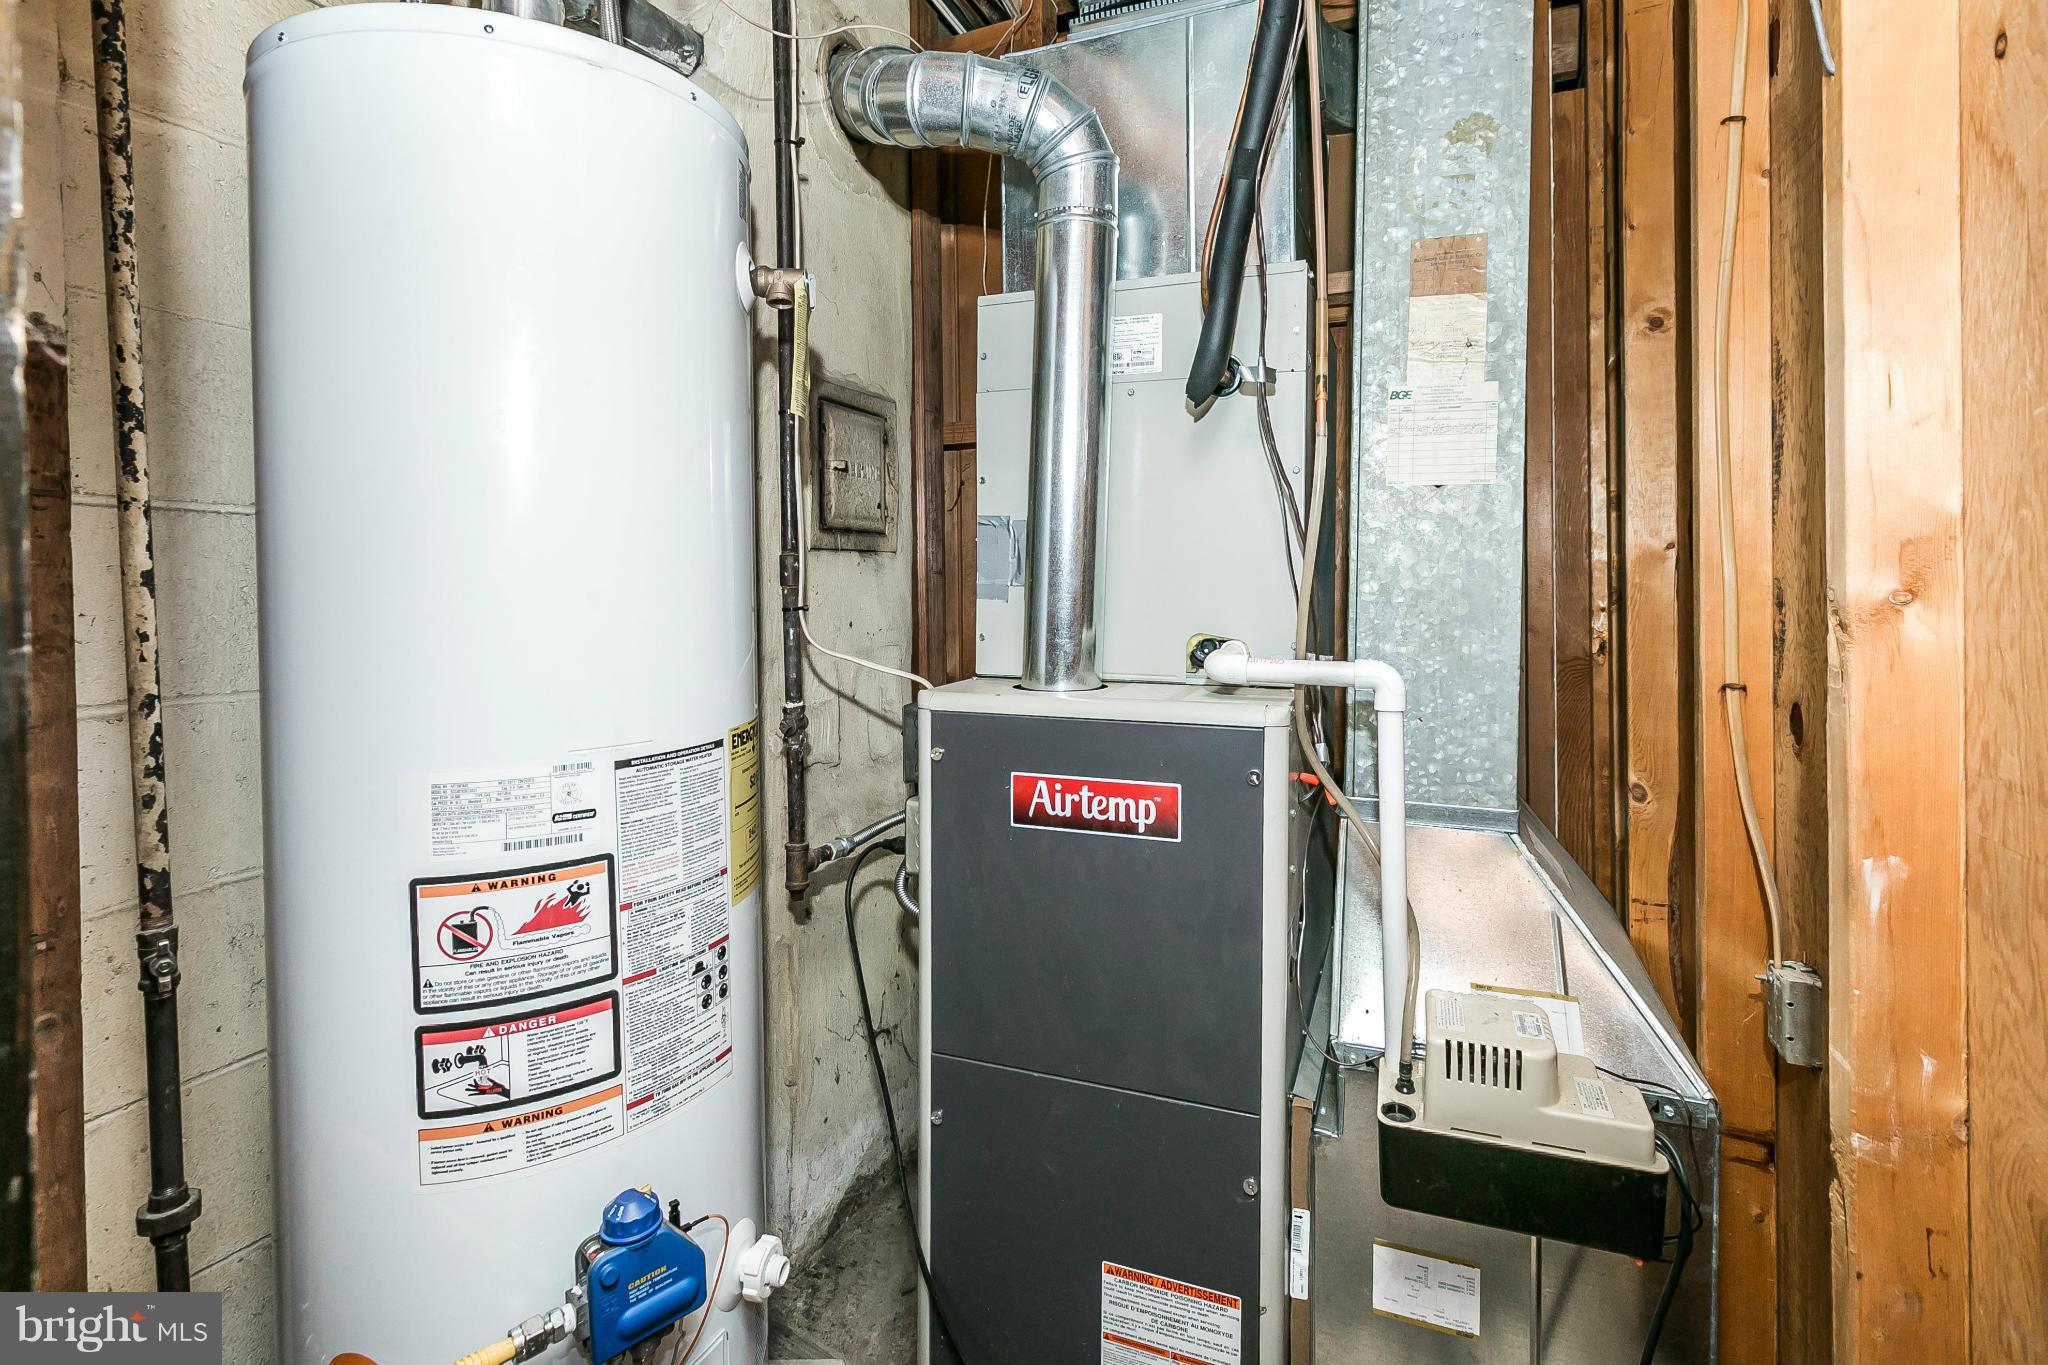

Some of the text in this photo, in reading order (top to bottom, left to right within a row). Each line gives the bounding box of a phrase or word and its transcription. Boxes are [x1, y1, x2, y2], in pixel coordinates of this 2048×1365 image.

[1390, 390, 1412, 400] BGE
[1028, 780, 1156, 833] Airtemp
[488, 873, 556, 890] WARNING
[512, 930, 574, 946] Flammable Vapors
[500, 954, 536, 964] EXPLOSION
[538, 948, 563, 958] HAZARD
[498, 1016, 557, 1034] DANGER
[501, 1106, 564, 1128] WARNING
[628, 1264, 667, 1290] CAUTION
[1114, 1266, 1153, 1285] WARNING
[1160, 1278, 1236, 1308] ADVERTISSEMENT
[1114, 1277, 1228, 1313] CARBON MONOXIDE POISONING HAZARD
[1108, 1298, 1128, 1310] RISQUE
[1200, 1326, 1232, 1339] MONOXYDE
[1160, 1320, 1188, 1333] CARBONE
